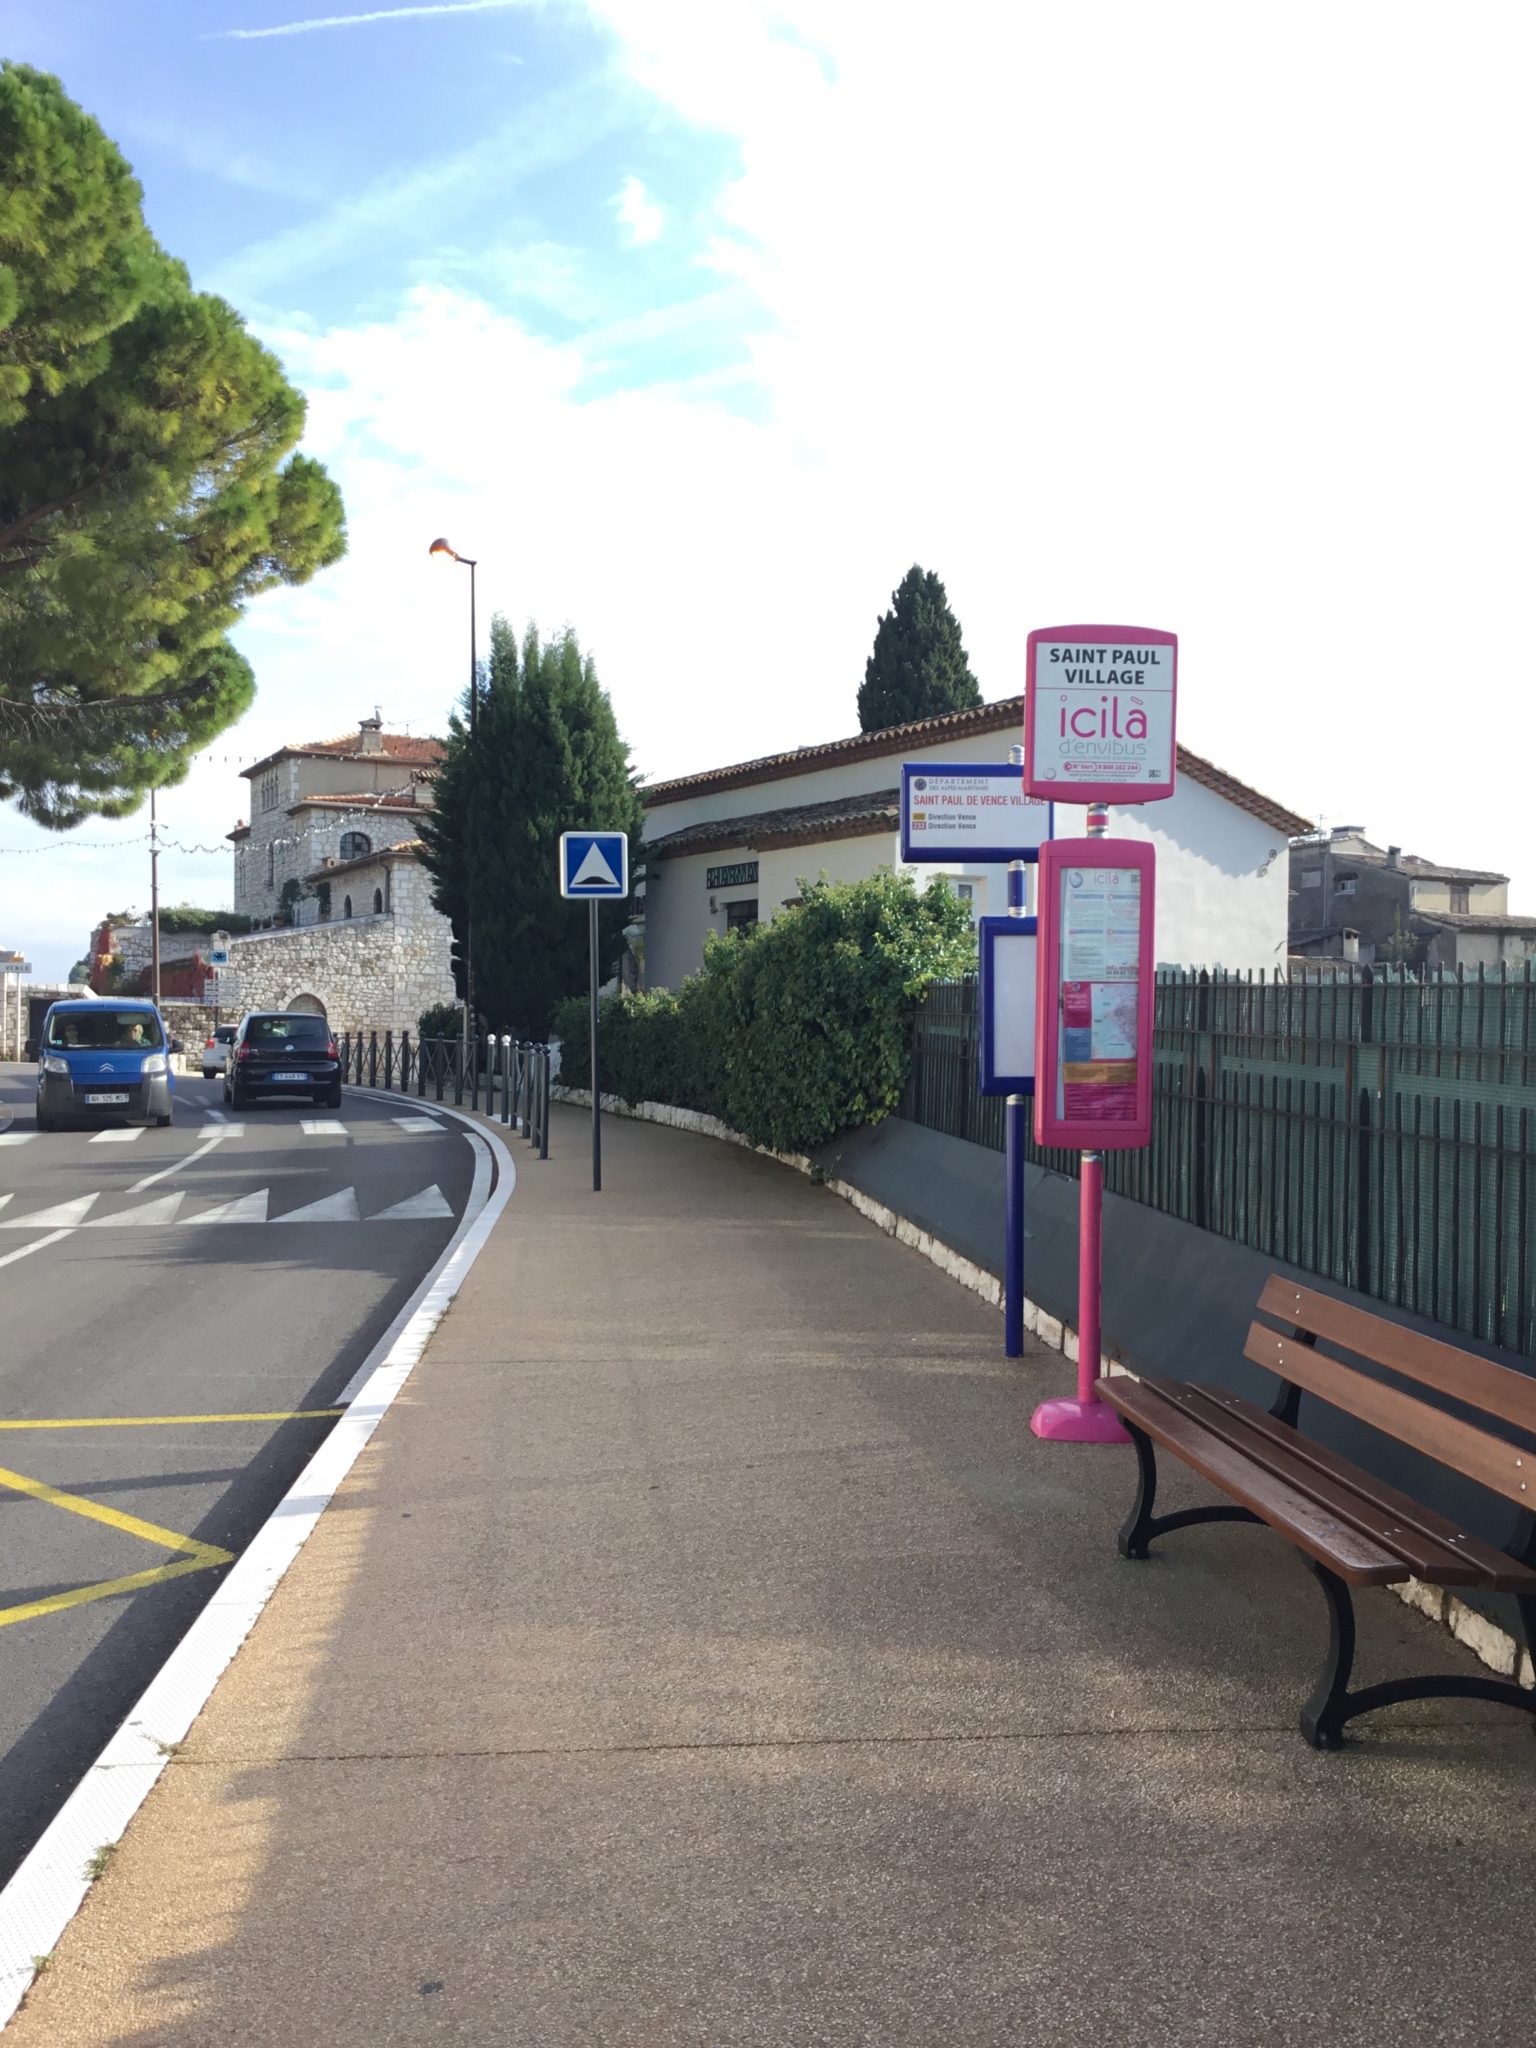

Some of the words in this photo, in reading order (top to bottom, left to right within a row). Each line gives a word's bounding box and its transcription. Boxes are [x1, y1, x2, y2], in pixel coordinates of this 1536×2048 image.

[1049, 648, 1107, 664] SAINT
[1112, 649, 1161, 665] PAUL
[1064, 669, 1145, 685] VILLAGE
[1060, 694, 1148, 739] icilà
[928, 777, 989, 785] DÉPARTEMENT
[913, 795, 939, 806] SAINT
[941, 795, 964, 806] PAUL
[966, 795, 979, 806] DE
[980, 795, 1008, 806] VENCE
[928, 822, 956, 830] Direction
[957, 822, 977, 830] Vence
[5, 964, 30, 972] VENCE
